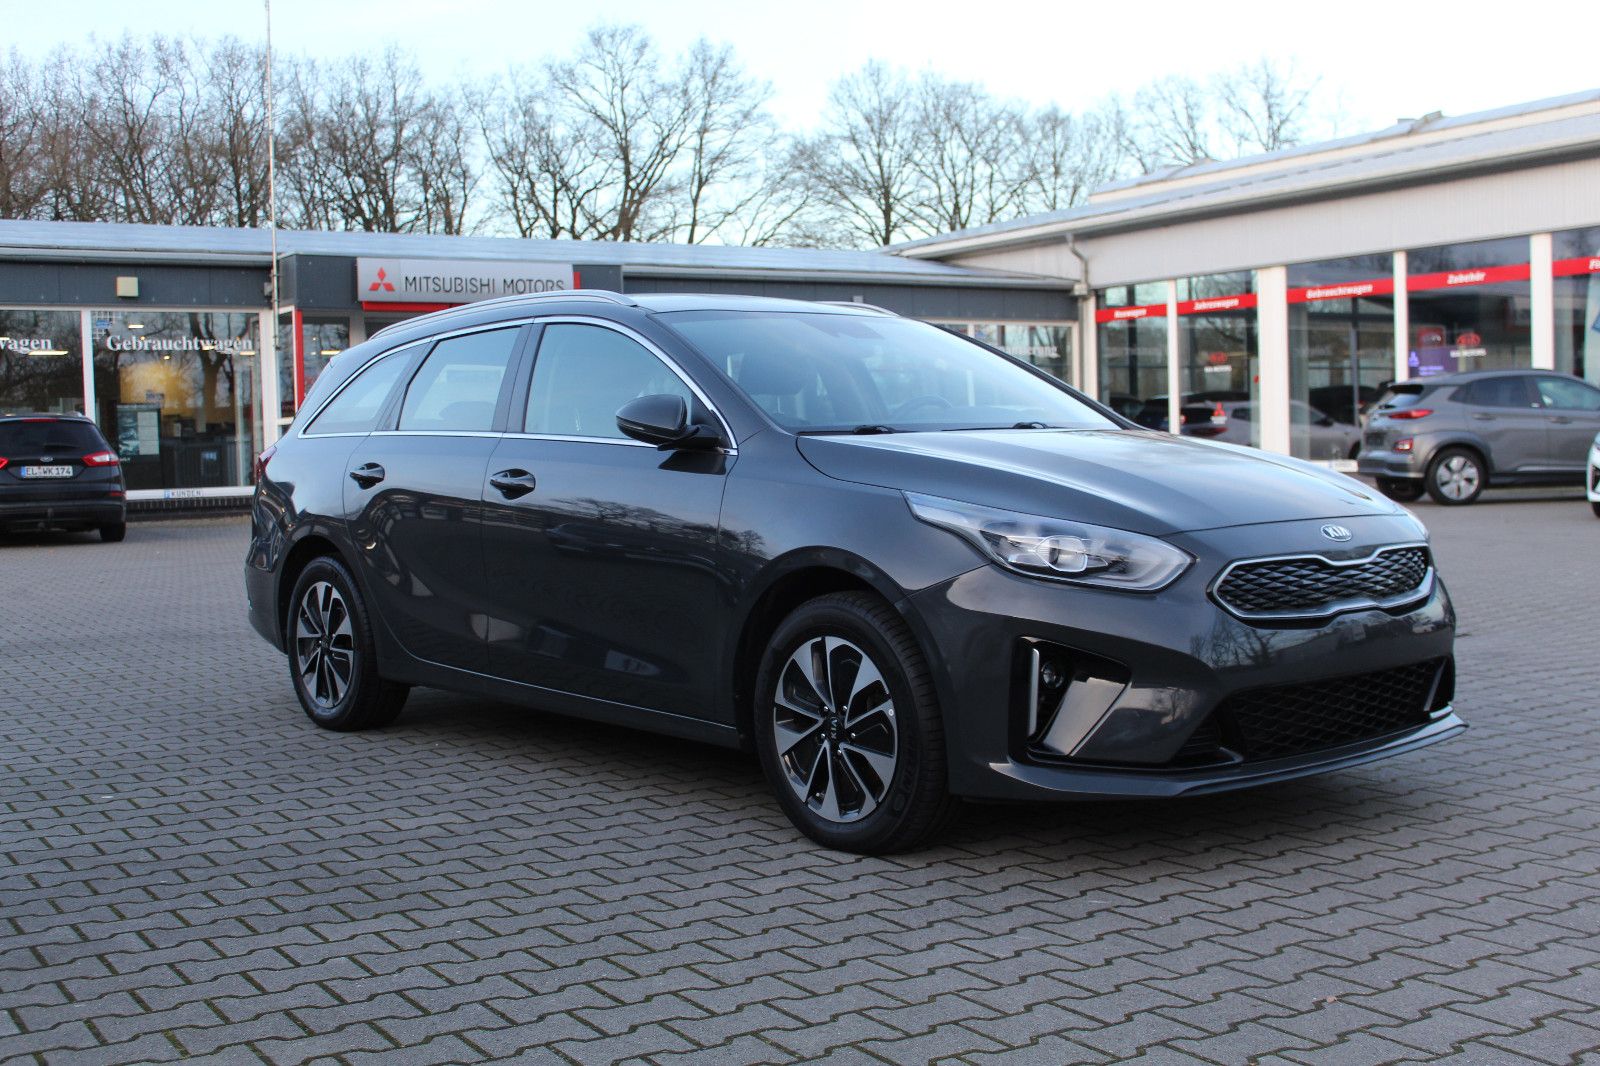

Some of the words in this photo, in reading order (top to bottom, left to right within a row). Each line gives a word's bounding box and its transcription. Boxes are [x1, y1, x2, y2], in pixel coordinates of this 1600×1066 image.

[405, 276, 495, 293] MITSUBISHI
[503, 278, 564, 294] MOTORS
[106, 335, 253, 354] Gebrauchtwagen
[57, 467, 72, 475] 174
[1322, 525, 1351, 539] KIA
